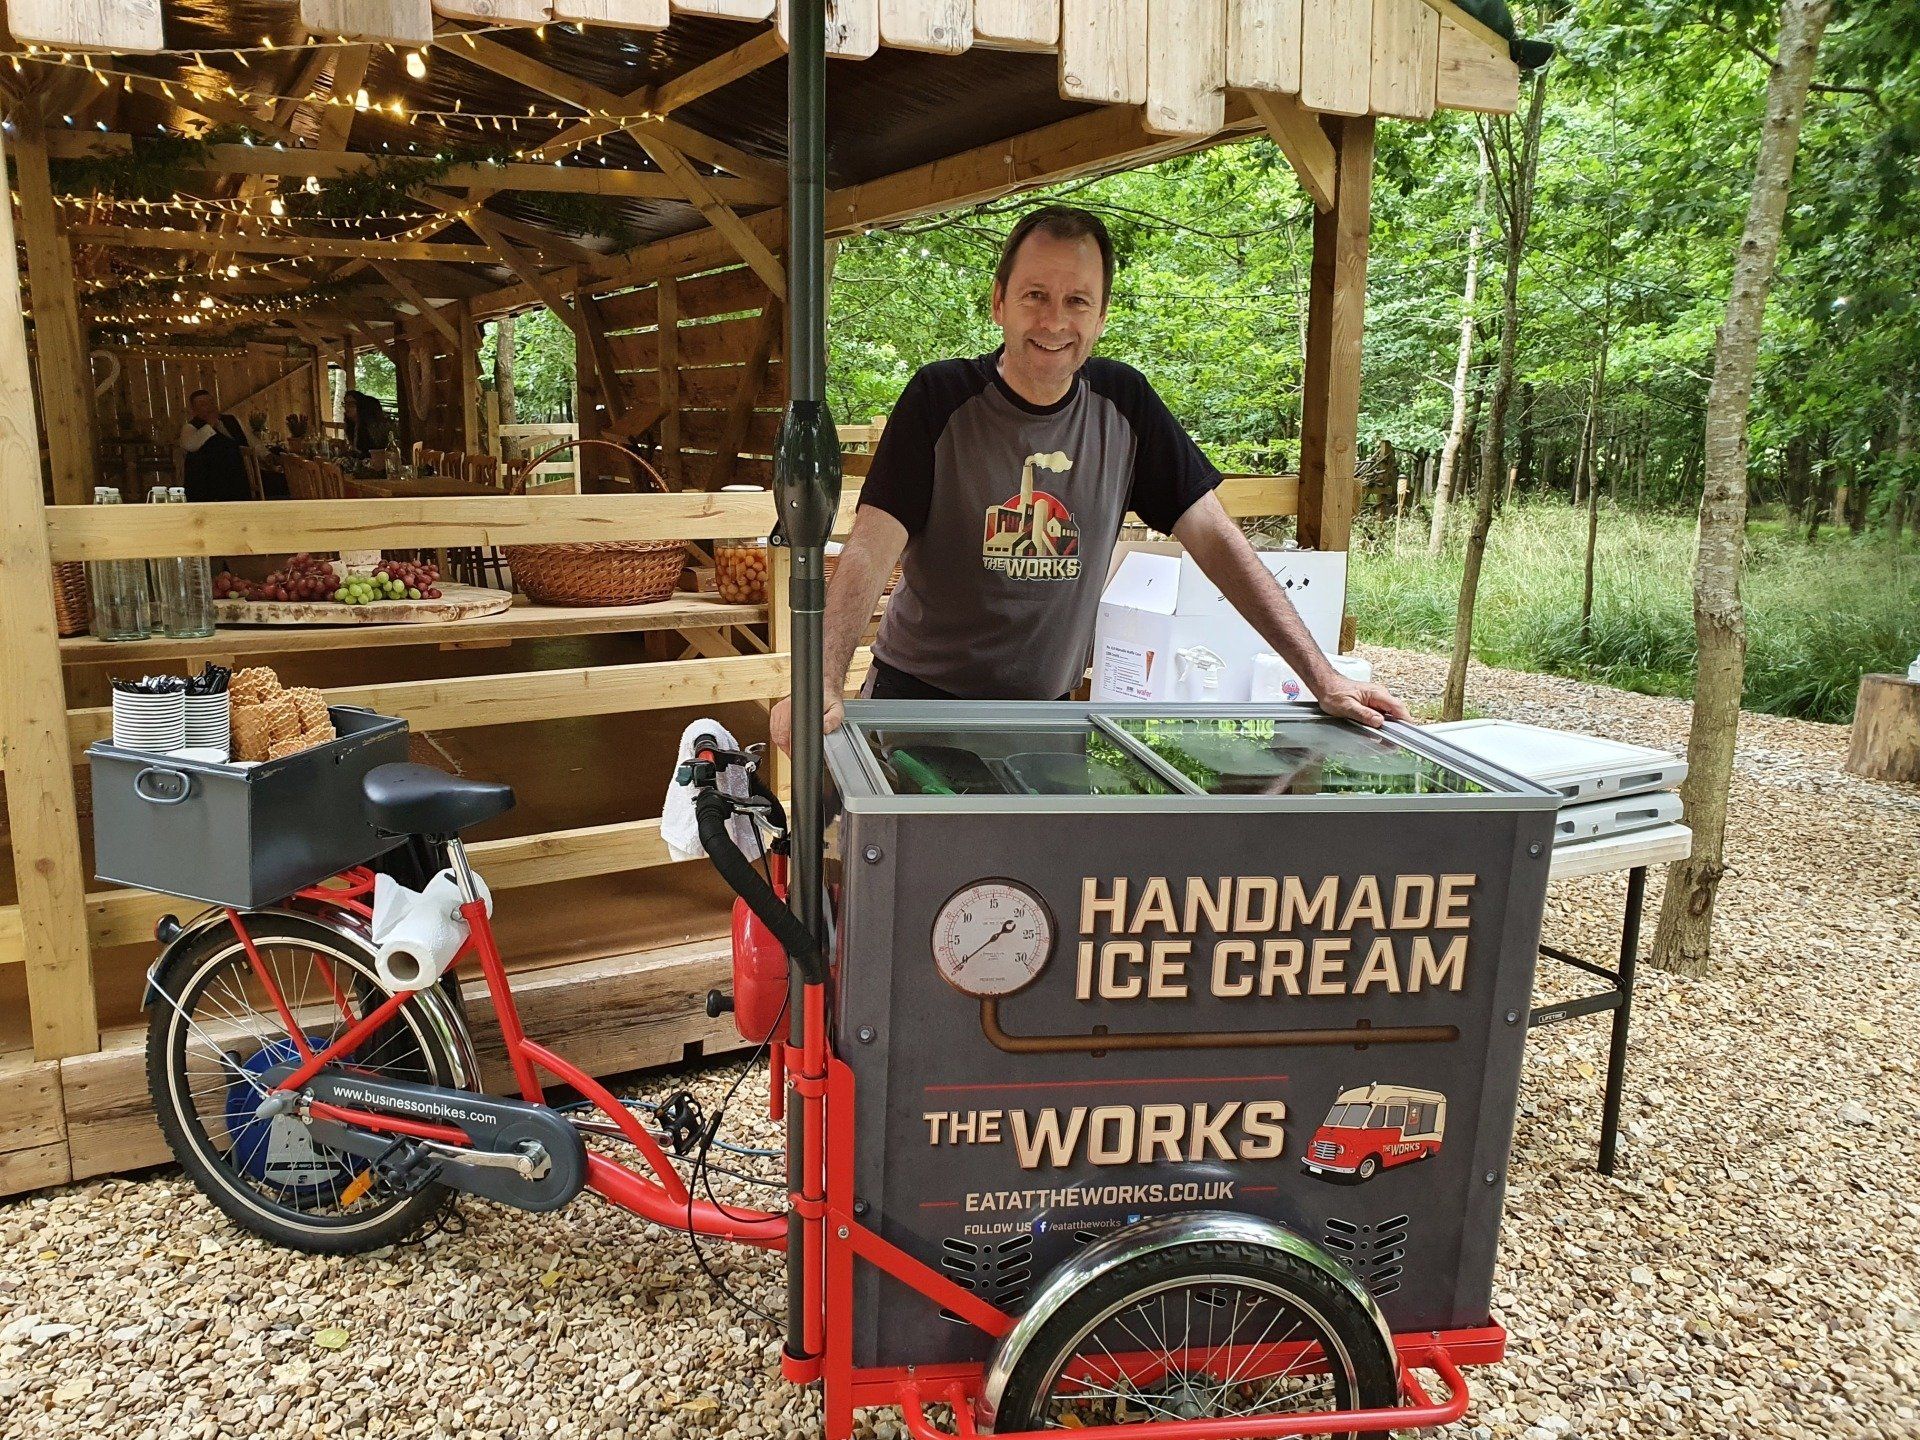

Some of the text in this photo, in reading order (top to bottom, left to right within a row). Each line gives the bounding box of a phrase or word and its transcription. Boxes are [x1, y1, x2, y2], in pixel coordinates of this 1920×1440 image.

[983, 557, 1081, 579] THE WORKS
[989, 899, 998, 909] 15
[1079, 874, 1476, 934] HANDMADE
[963, 912, 972, 923] 10
[1013, 908, 1024, 918] 20
[954, 935, 960, 945] 5
[1023, 930, 1034, 940] 25
[1075, 935, 1469, 1000] ICE CREAM
[333, 1084, 497, 1125] www.businessonbikes.com
[922, 1100, 1286, 1169] THE WORKS
[1390, 1142, 1420, 1156] WORKS
[965, 1181, 1235, 1212] EATATTHEWORKS.CO.UK
[964, 1222, 1013, 1235] FOLLOW
[1016, 1222, 1032, 1232] US
